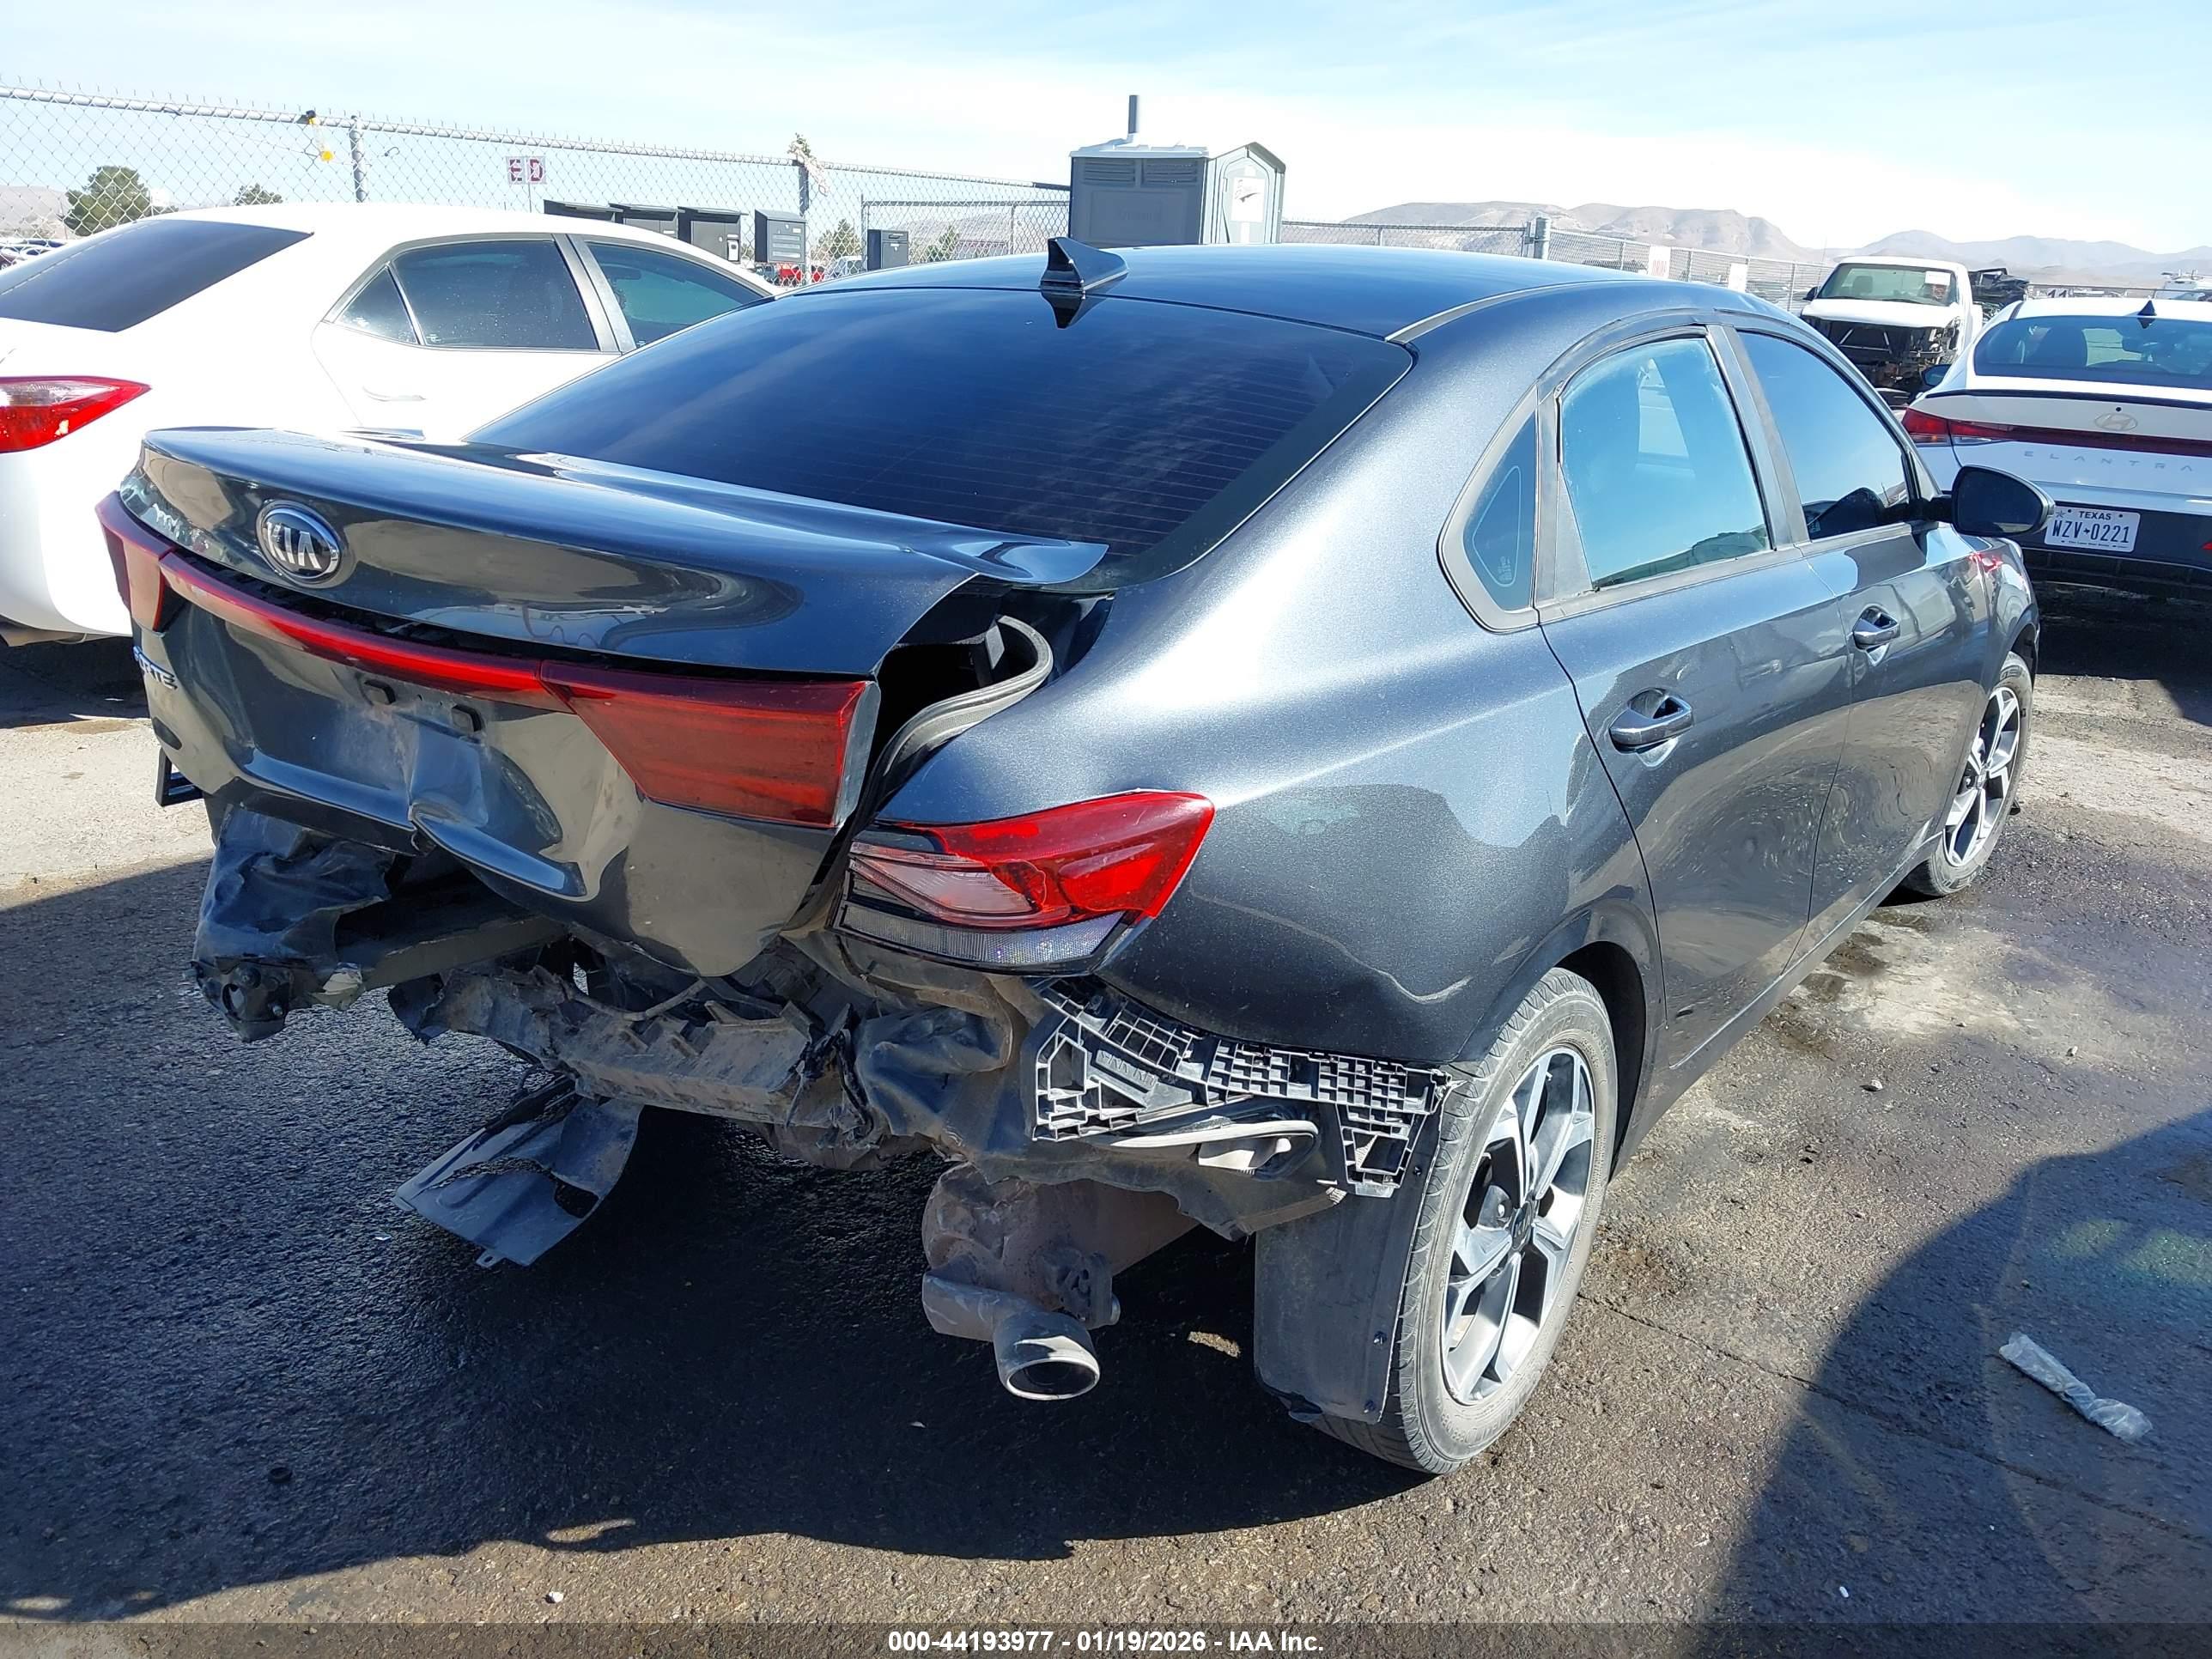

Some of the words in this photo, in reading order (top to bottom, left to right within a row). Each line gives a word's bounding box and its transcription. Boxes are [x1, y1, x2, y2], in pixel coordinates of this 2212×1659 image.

[2023, 450, 2193, 472] ELANTRA
[2078, 510, 2112, 520] TEXAS
[265, 520, 323, 570] KIA
